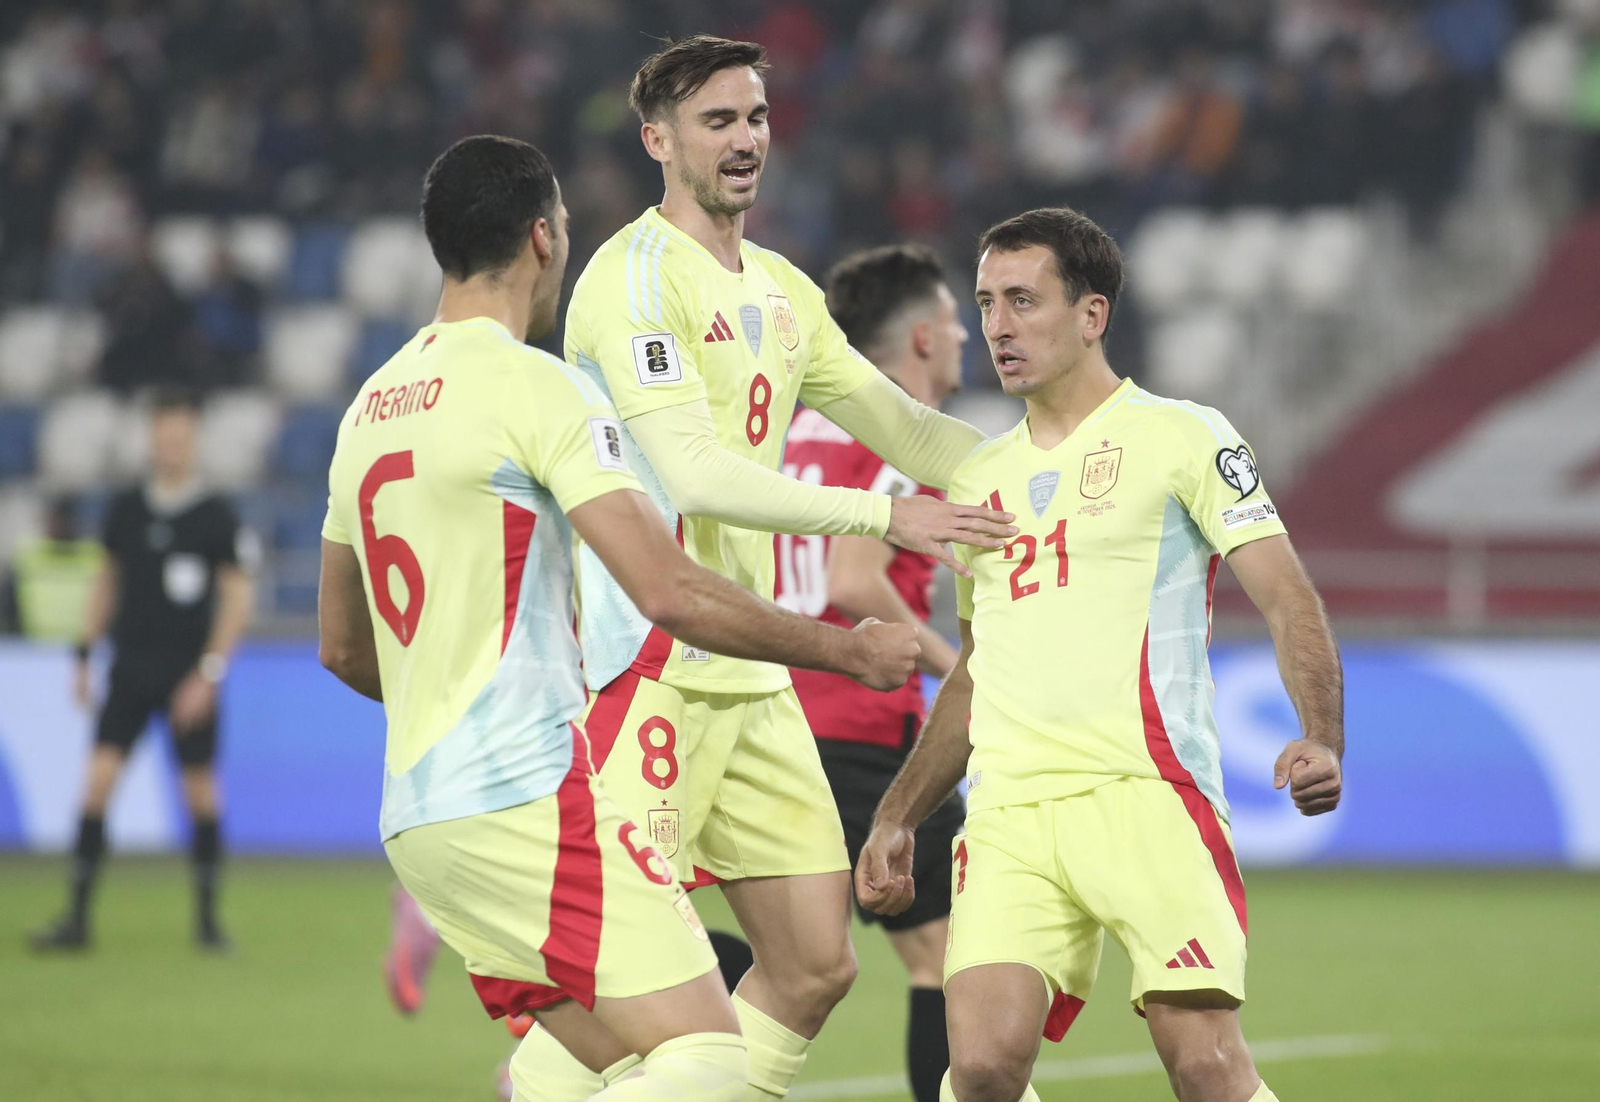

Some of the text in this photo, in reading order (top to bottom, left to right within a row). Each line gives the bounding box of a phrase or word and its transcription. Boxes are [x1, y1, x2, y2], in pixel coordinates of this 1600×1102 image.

[355, 377, 444, 427] MERINO
[745, 372, 772, 447] 8
[358, 449, 425, 648] 6
[1003, 518, 1069, 602] 21
[637, 715, 679, 790] 8
[617, 820, 672, 885] 6
